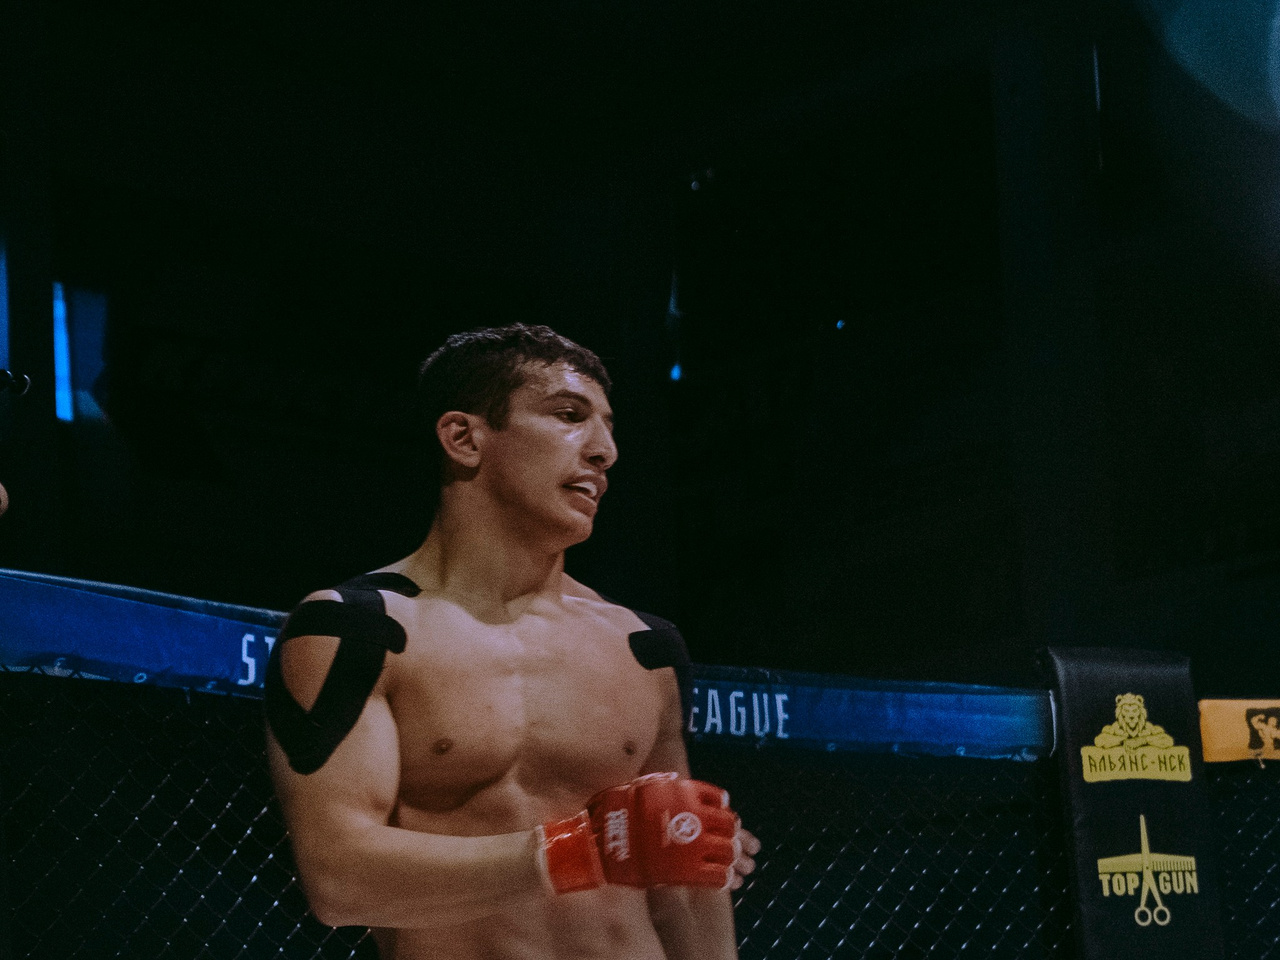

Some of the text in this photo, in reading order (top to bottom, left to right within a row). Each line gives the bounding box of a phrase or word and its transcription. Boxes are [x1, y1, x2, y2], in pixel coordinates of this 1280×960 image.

[688, 687, 790, 739] EAGUE
[1088, 752, 1187, 775] АЛЬЯНС-НСК
[1099, 870, 1199, 897] TOP GUN
